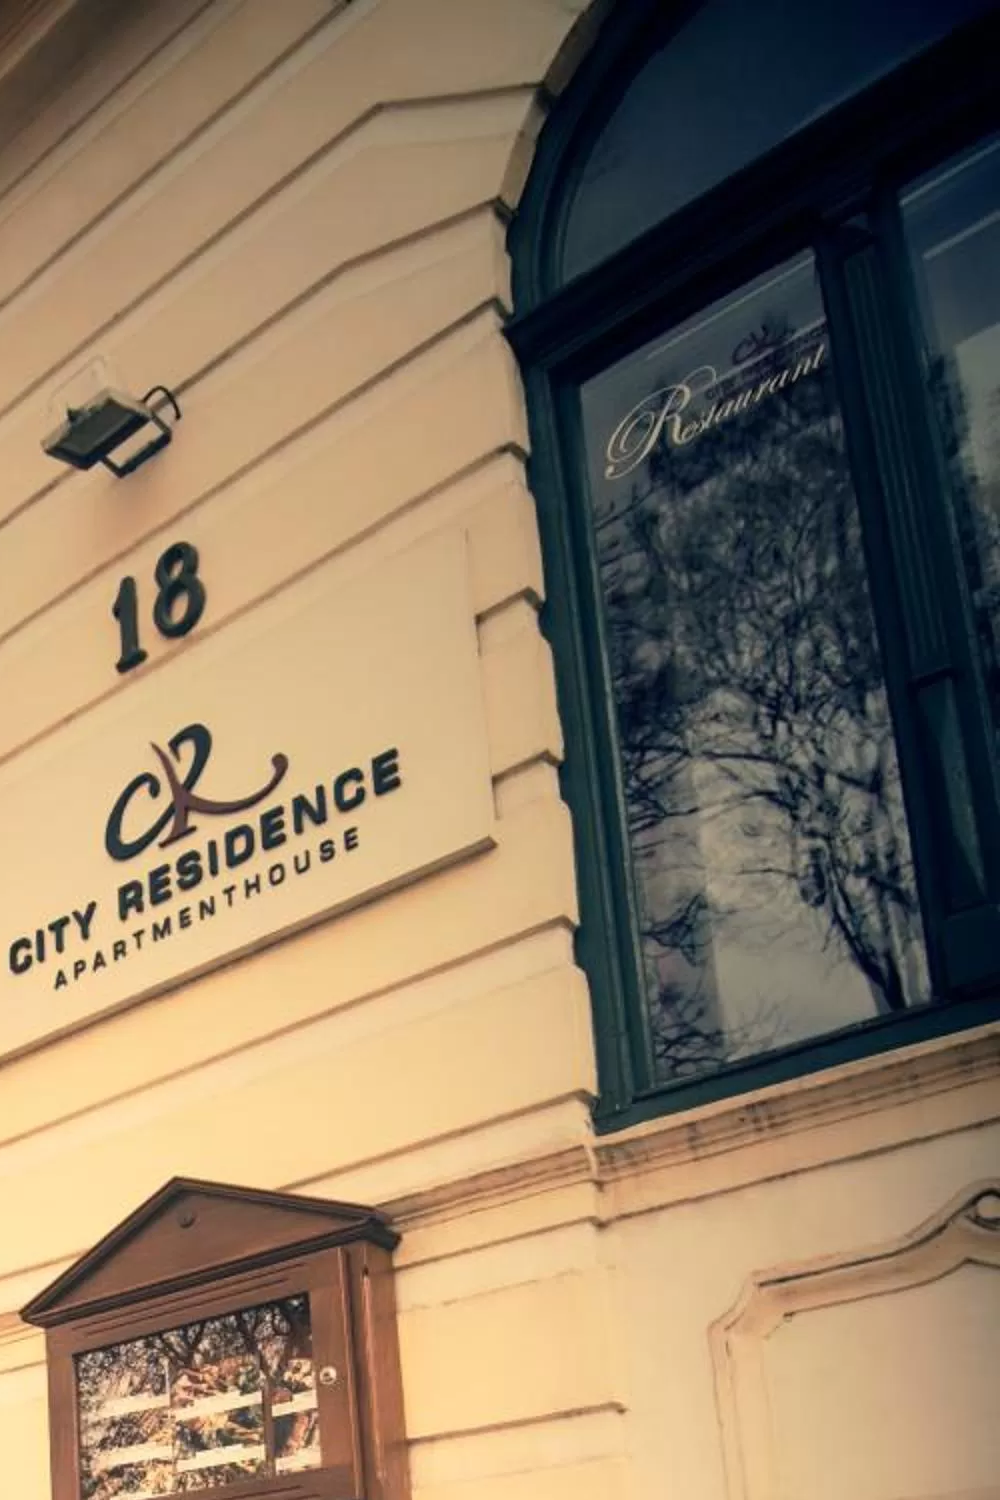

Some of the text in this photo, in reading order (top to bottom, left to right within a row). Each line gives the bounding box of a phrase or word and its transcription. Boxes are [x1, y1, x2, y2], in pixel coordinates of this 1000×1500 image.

[605, 343, 825, 480] Restaurant
[112, 541, 207, 674] 18
[8, 747, 402, 975] CITY RESIDENCE
[53, 827, 360, 990] APARTMENTHOUSE
